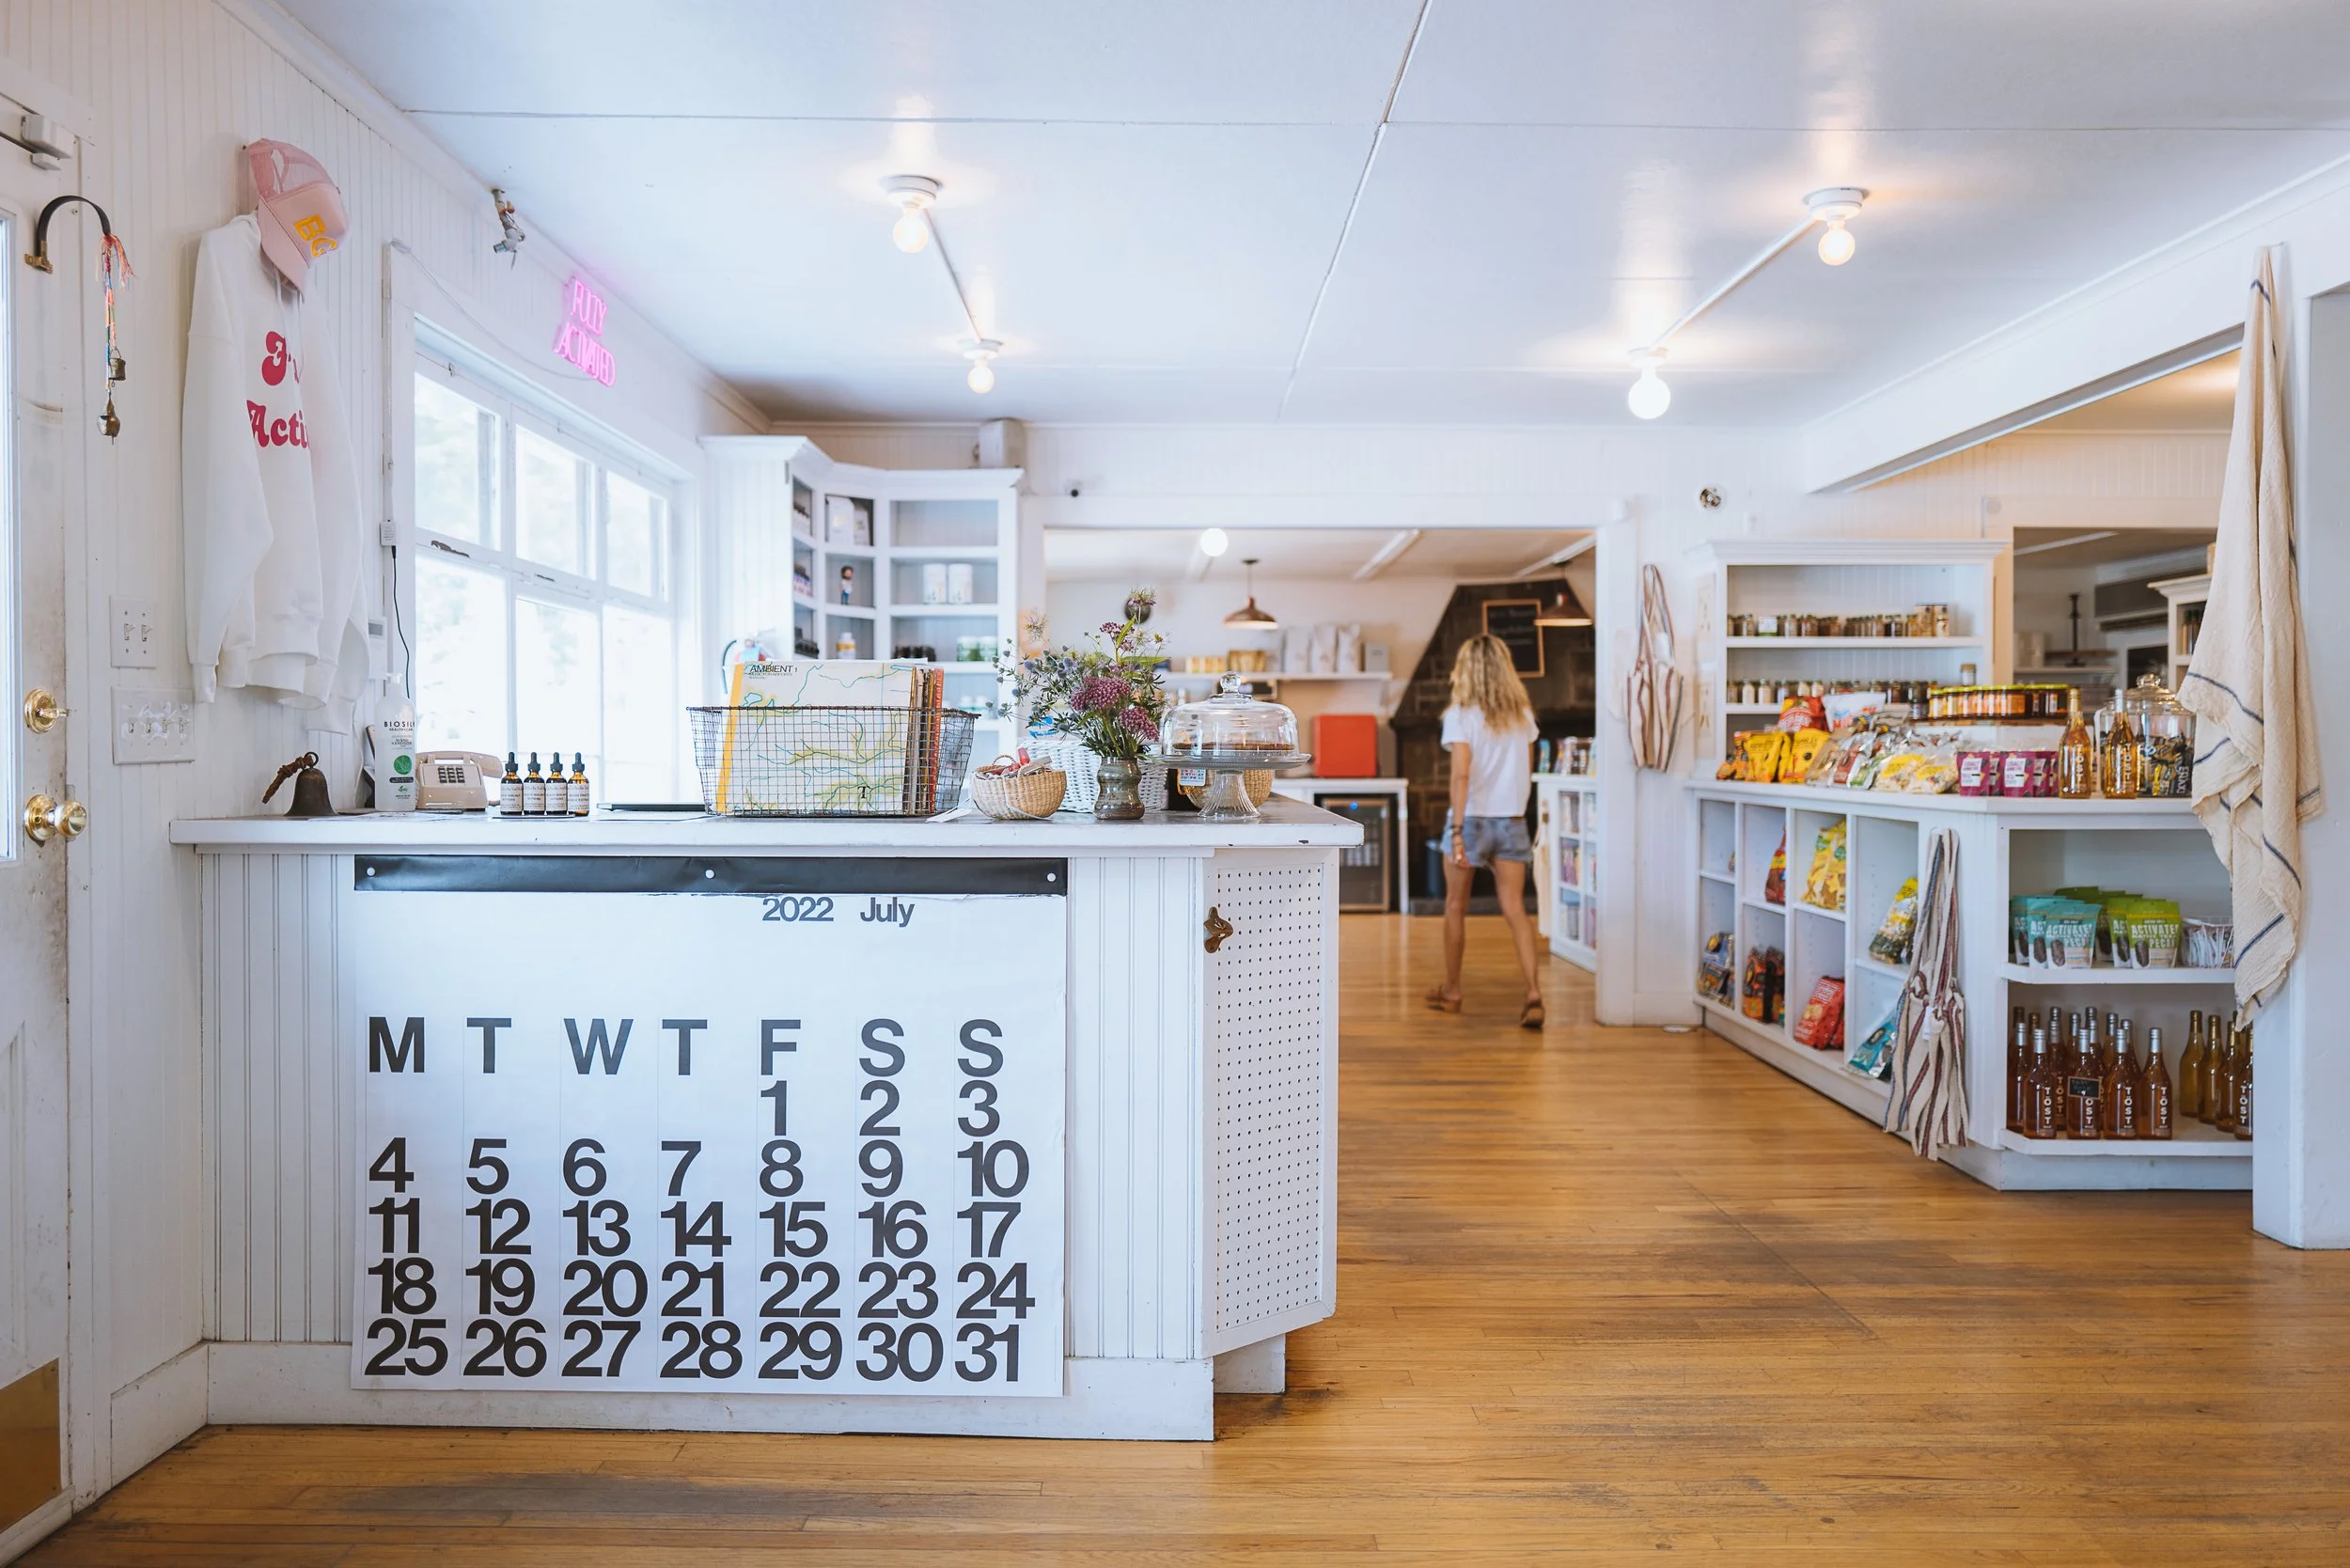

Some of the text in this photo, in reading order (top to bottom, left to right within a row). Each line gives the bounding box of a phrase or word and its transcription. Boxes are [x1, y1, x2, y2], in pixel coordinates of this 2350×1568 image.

[570, 278, 609, 337] FULLY
[553, 321, 617, 387] ACTIVATED
[246, 400, 310, 448] Acti
[749, 665, 794, 673] AMBIENT
[762, 896, 916, 928] 2022 July
[369, 1017, 1004, 1077] M T W T F S S
[760, 1080, 1000, 1137] 1 2 3
[2044, 1086, 2052, 1125] TÖST
[2123, 1086, 2133, 1125] TÖST
[2159, 1086, 2169, 1125] TÖST
[2239, 1085, 2248, 1125] TÖST
[369, 1137, 1029, 1199] 4 5 6 7 8 9 10
[369, 1198, 1022, 1259] 11 12 13 14 15 16 17
[368, 1257, 1036, 1319] 18 19 20 21 22 23 24
[365, 1318, 1020, 1382] 25 26 27 28 29 30 31
